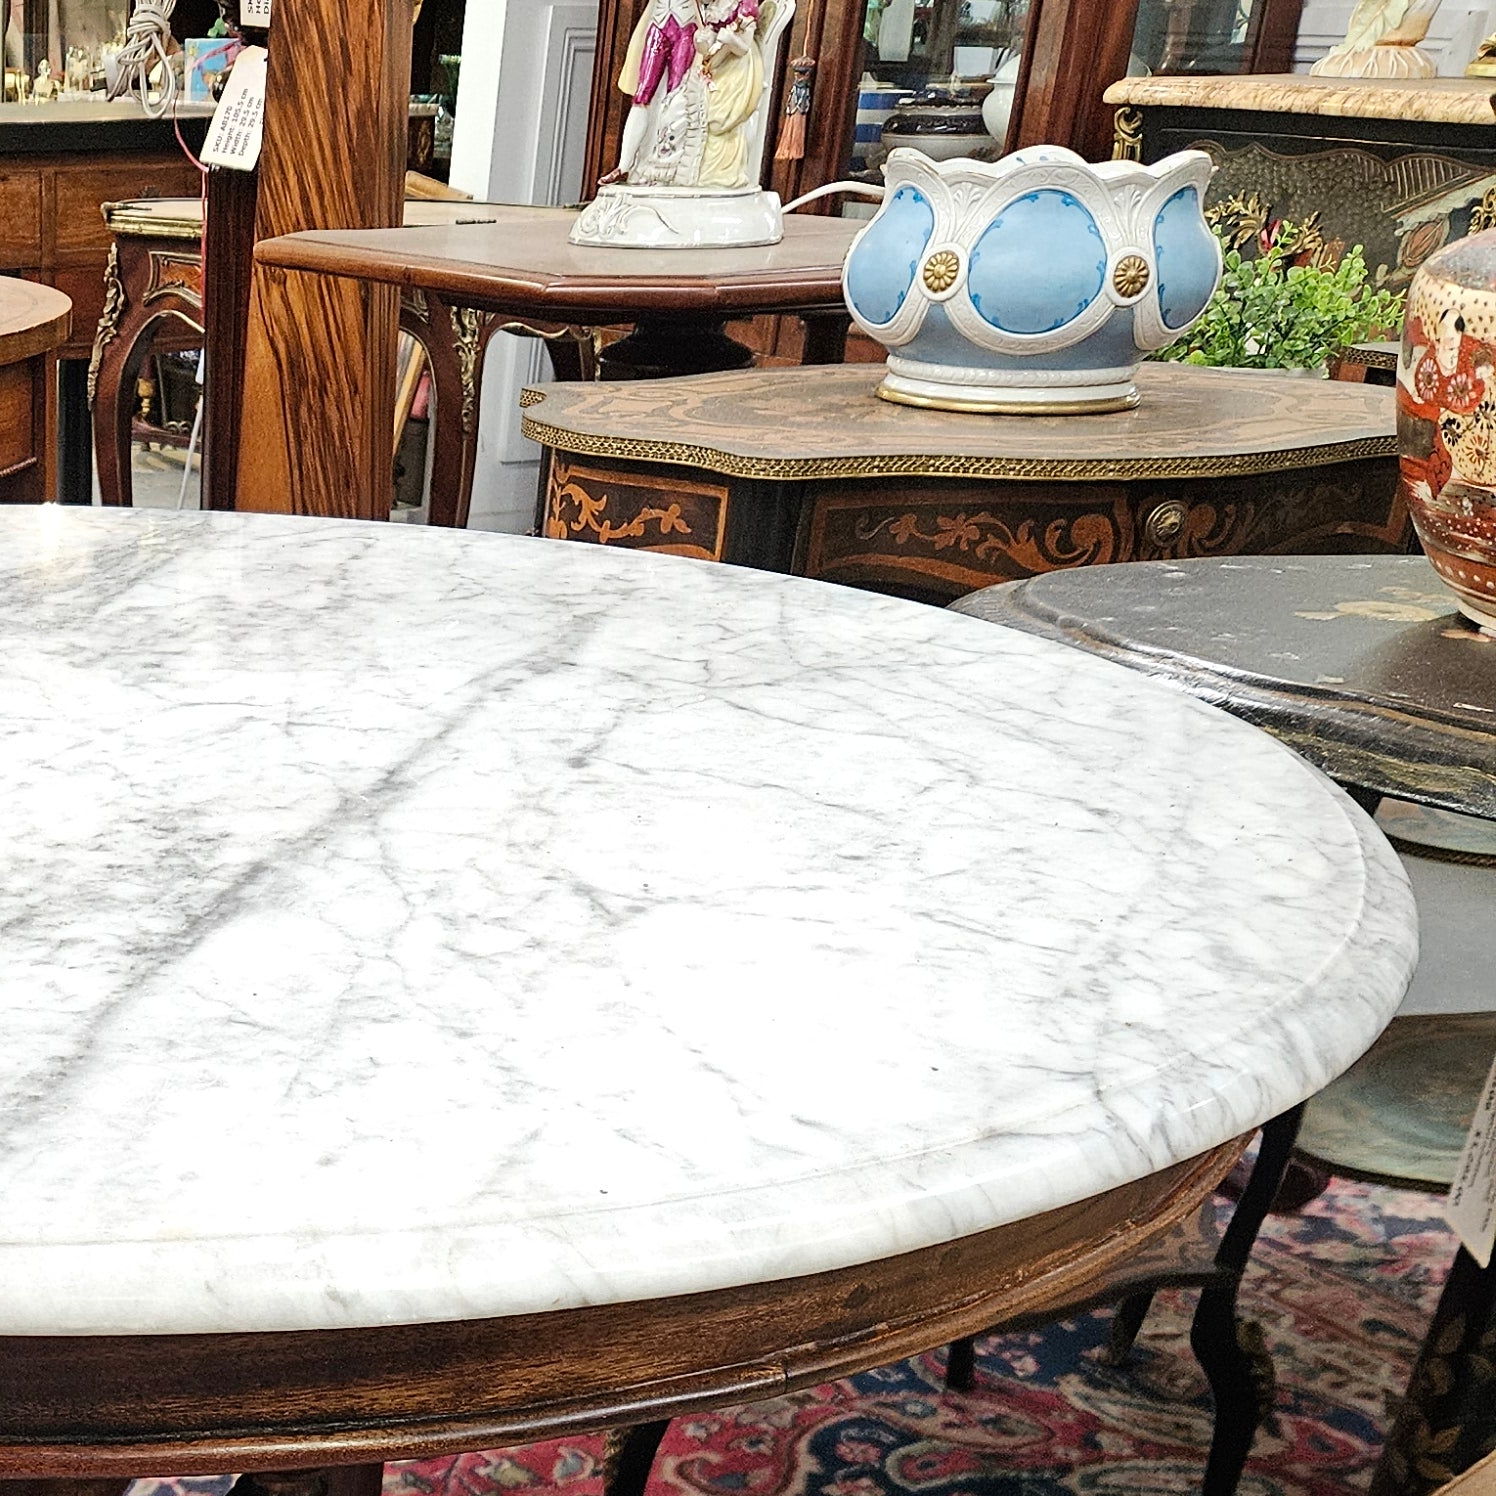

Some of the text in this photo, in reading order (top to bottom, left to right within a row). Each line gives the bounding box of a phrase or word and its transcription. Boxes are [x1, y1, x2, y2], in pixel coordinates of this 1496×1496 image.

[241, 88, 249, 100] cm
[230, 129, 244, 155] Width:
[247, 96, 255, 108] cm
[238, 131, 252, 157] Depth:
